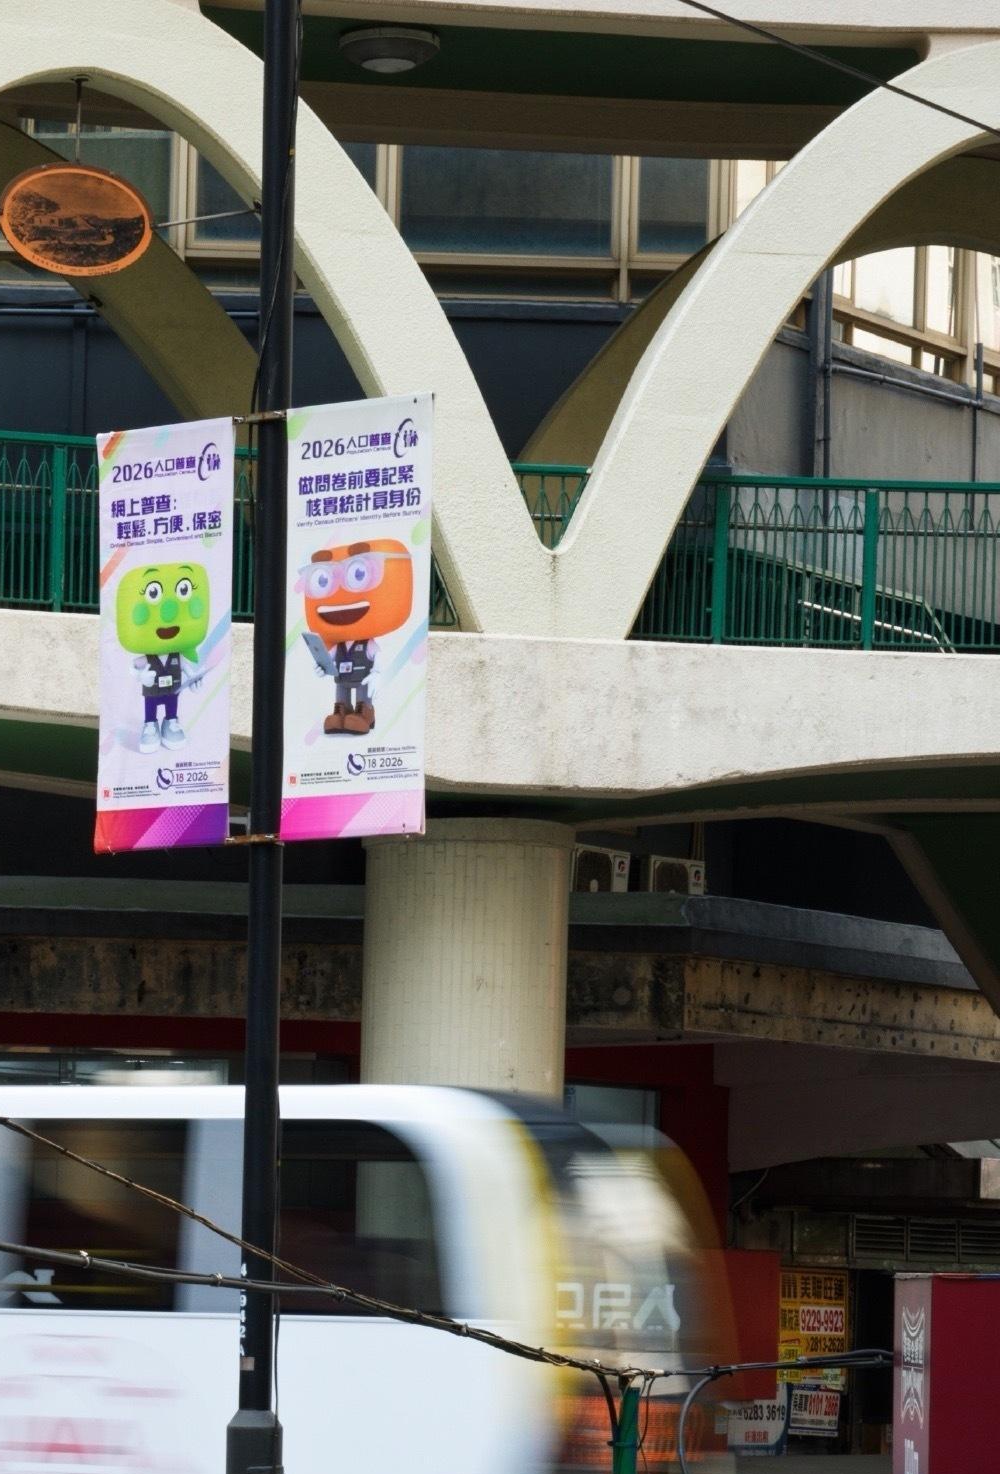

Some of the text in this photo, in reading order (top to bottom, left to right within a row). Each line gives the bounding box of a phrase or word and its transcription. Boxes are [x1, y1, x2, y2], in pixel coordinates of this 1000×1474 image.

[301, 432, 391, 460] 2026 人口普查
[112, 456, 196, 483] 2026 人口普查
[298, 464, 414, 495] 做問卷前要記緊
[306, 487, 421, 518] 核實統計員身份
[314, 518, 334, 526] Census
[402, 509, 422, 518] Survey
[368, 757, 402, 768] 18 2026
[176, 771, 208, 782] 18 2026
[239, 1263, 247, 1356] 4942A
[801, 1308, 844, 1332] 9229-9923
